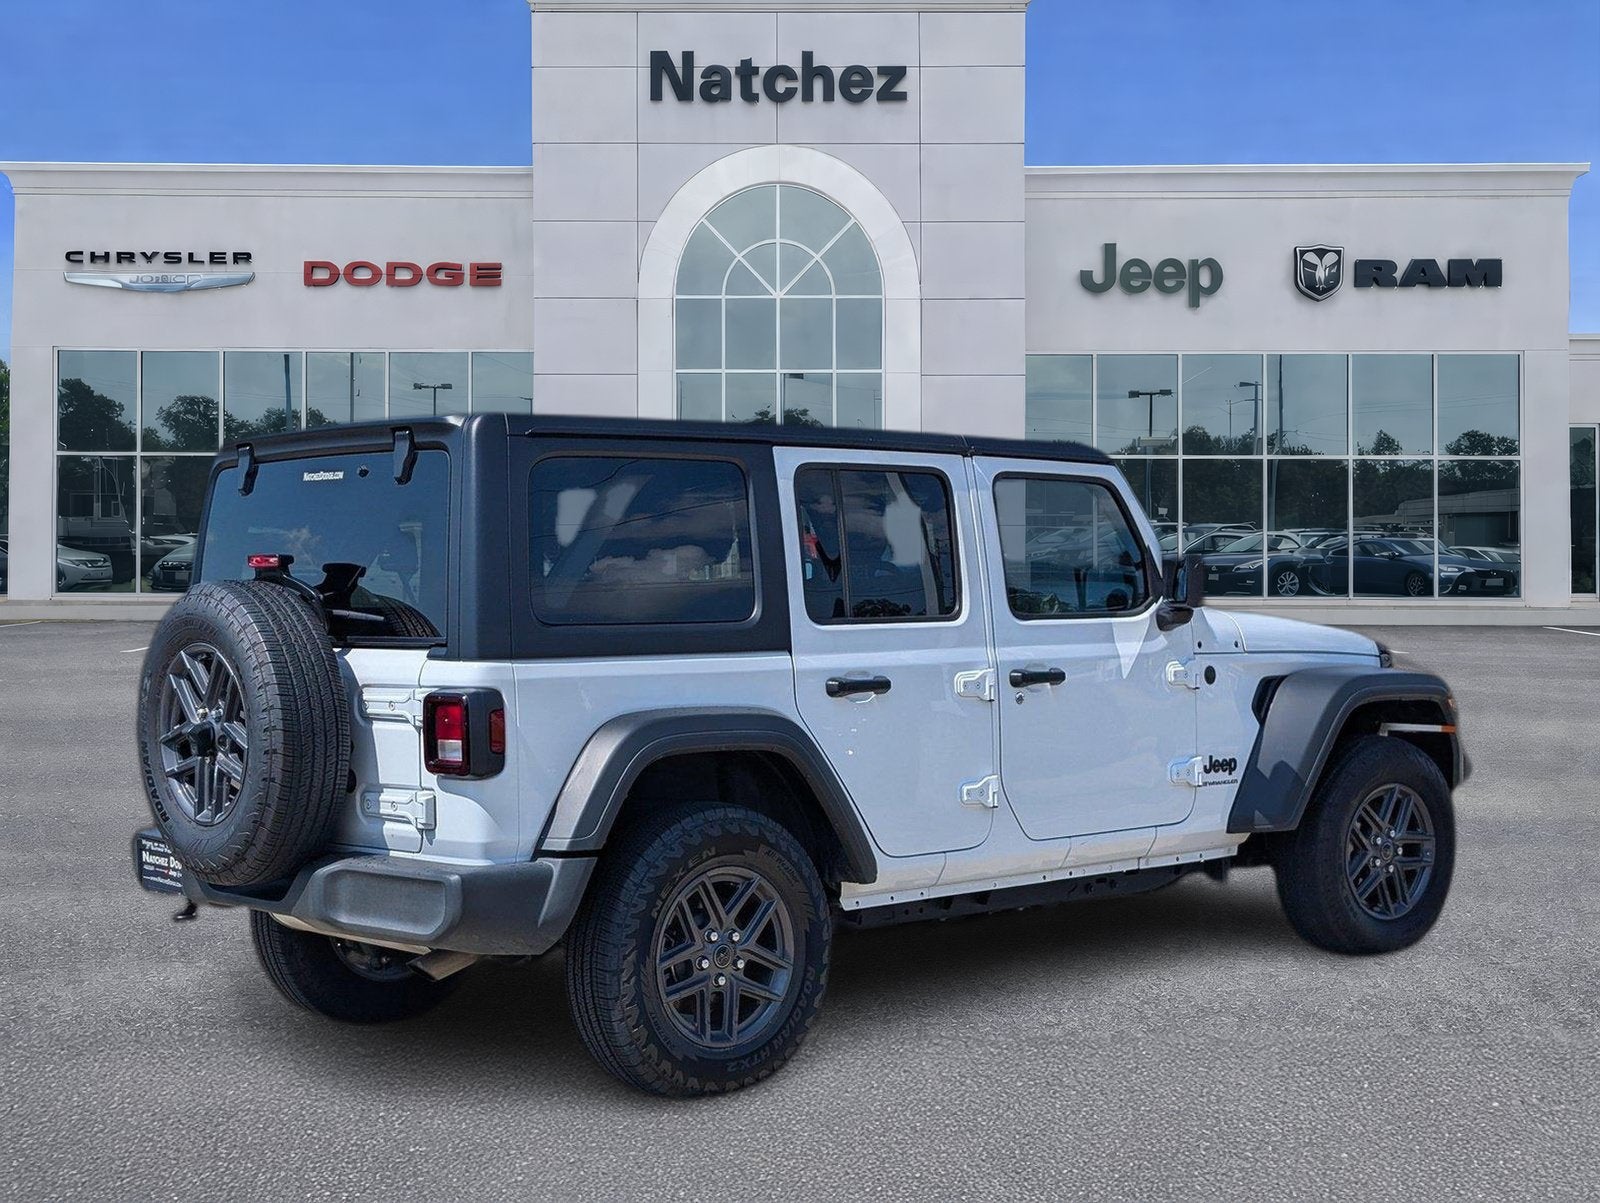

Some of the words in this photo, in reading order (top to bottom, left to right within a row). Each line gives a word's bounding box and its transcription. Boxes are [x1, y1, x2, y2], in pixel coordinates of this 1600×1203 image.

[649, 50, 908, 103] Natchez
[65, 250, 253, 266] CHRYSLER
[303, 260, 503, 287] DODGE
[1079, 242, 1224, 309] Jeep
[1353, 258, 1503, 288] RAM
[1203, 754, 1238, 776] Jeep
